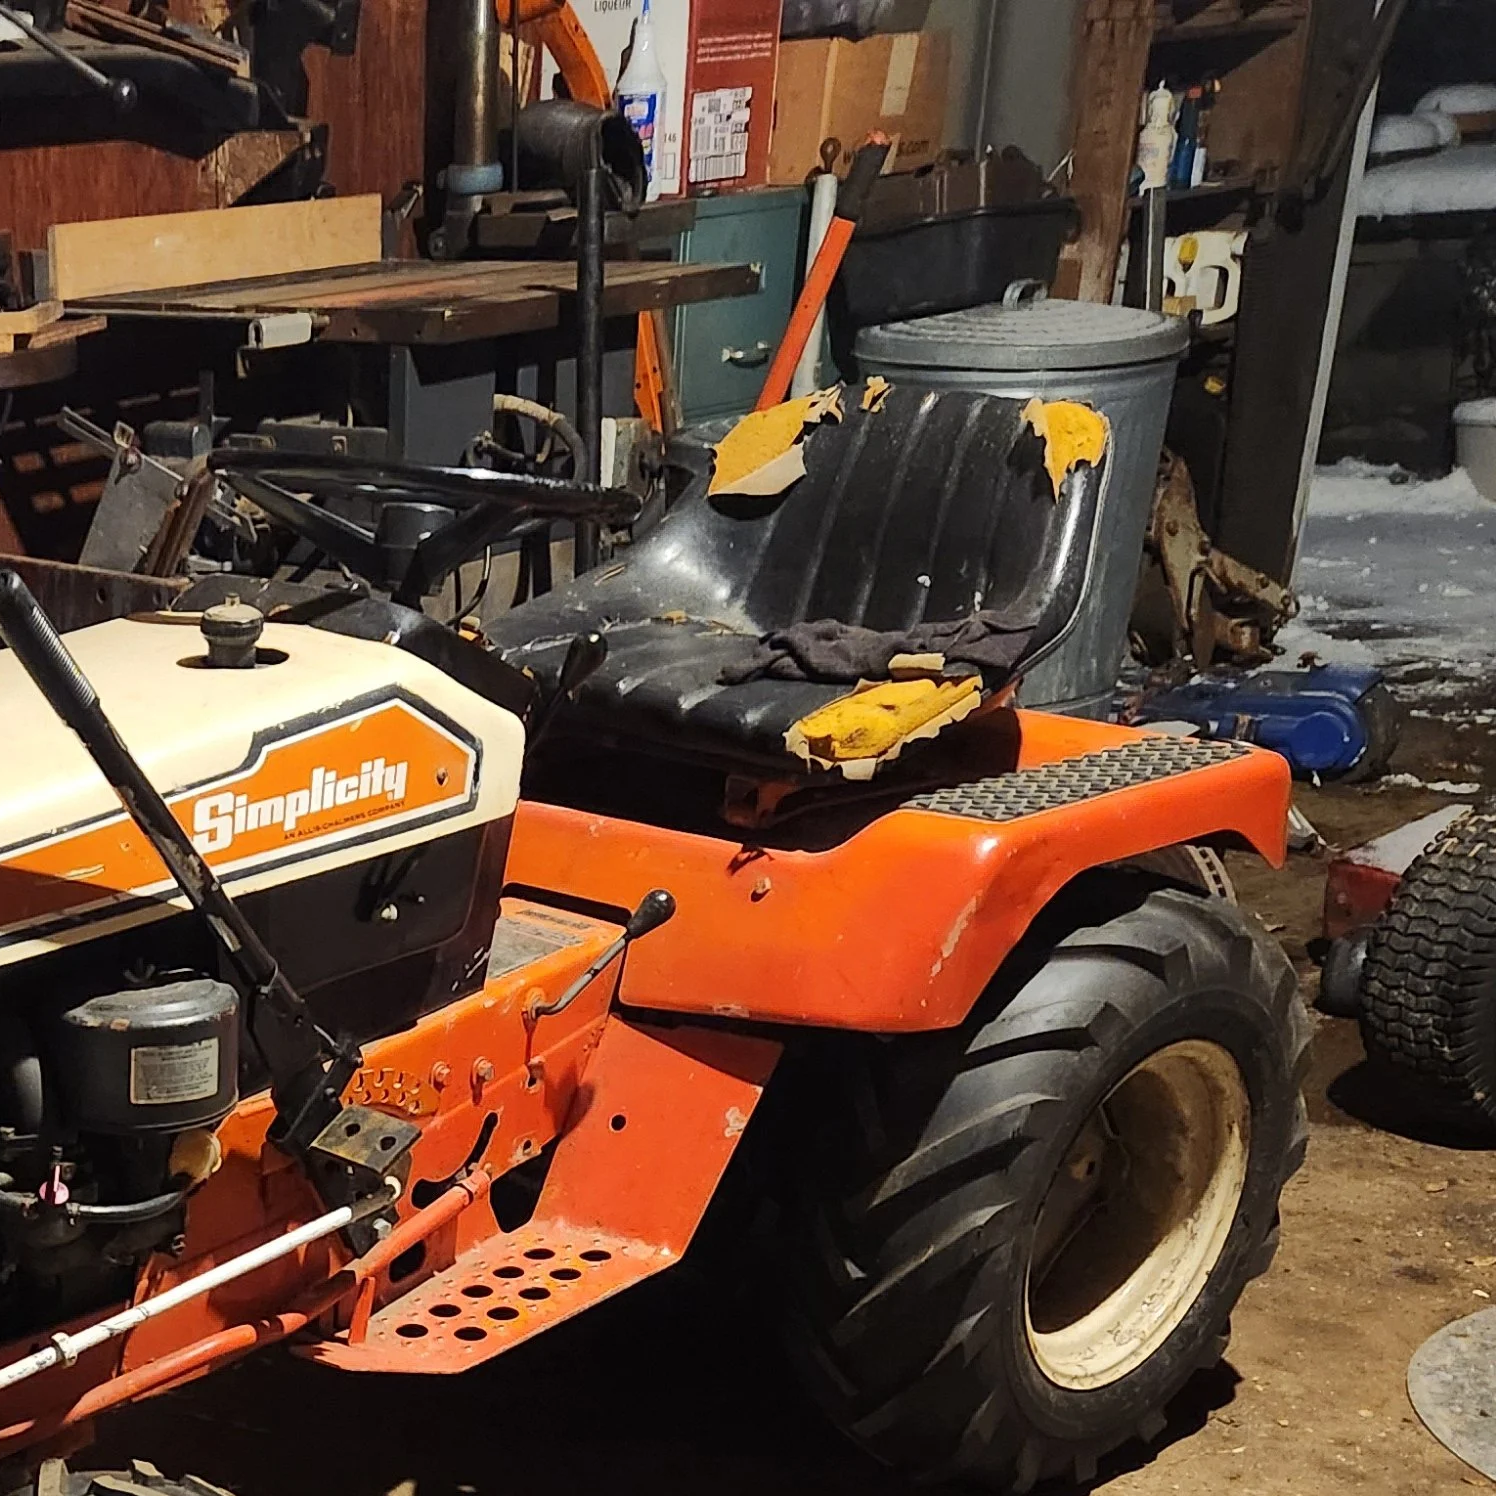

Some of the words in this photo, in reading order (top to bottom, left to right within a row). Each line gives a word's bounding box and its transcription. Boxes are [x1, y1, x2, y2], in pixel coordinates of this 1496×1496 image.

[192, 757, 408, 854] Simplicity
[283, 831, 296, 840] AN
[367, 801, 406, 817] COMPANY
